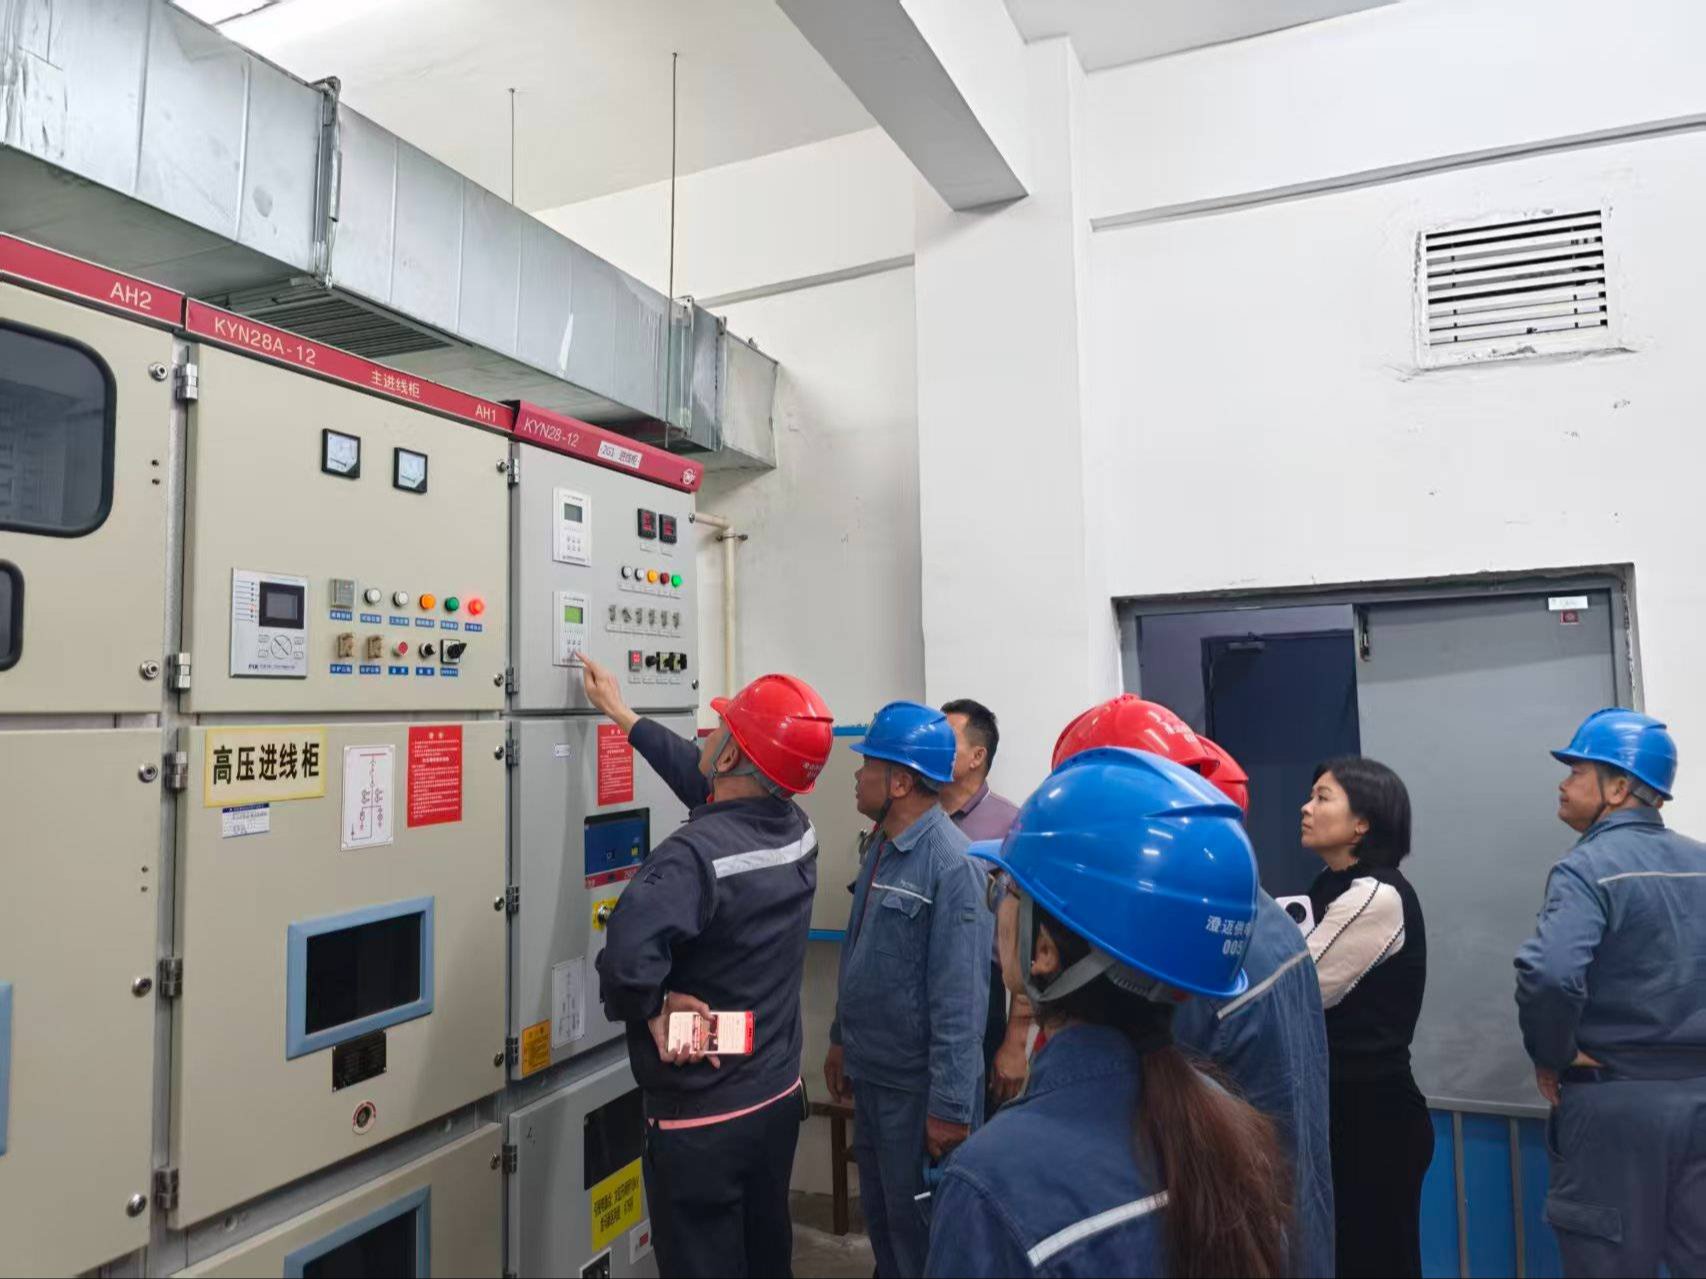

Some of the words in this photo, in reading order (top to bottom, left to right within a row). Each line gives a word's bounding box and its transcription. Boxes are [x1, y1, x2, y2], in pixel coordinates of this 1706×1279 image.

[110, 282, 152, 310] AH2
[214, 316, 316, 365] KYN28A-12
[371, 370, 420, 398] 主进线柜
[475, 404, 496, 422] AH1
[523, 417, 580, 448] KYN28-12
[213, 741, 320, 785] 高压进线柜
